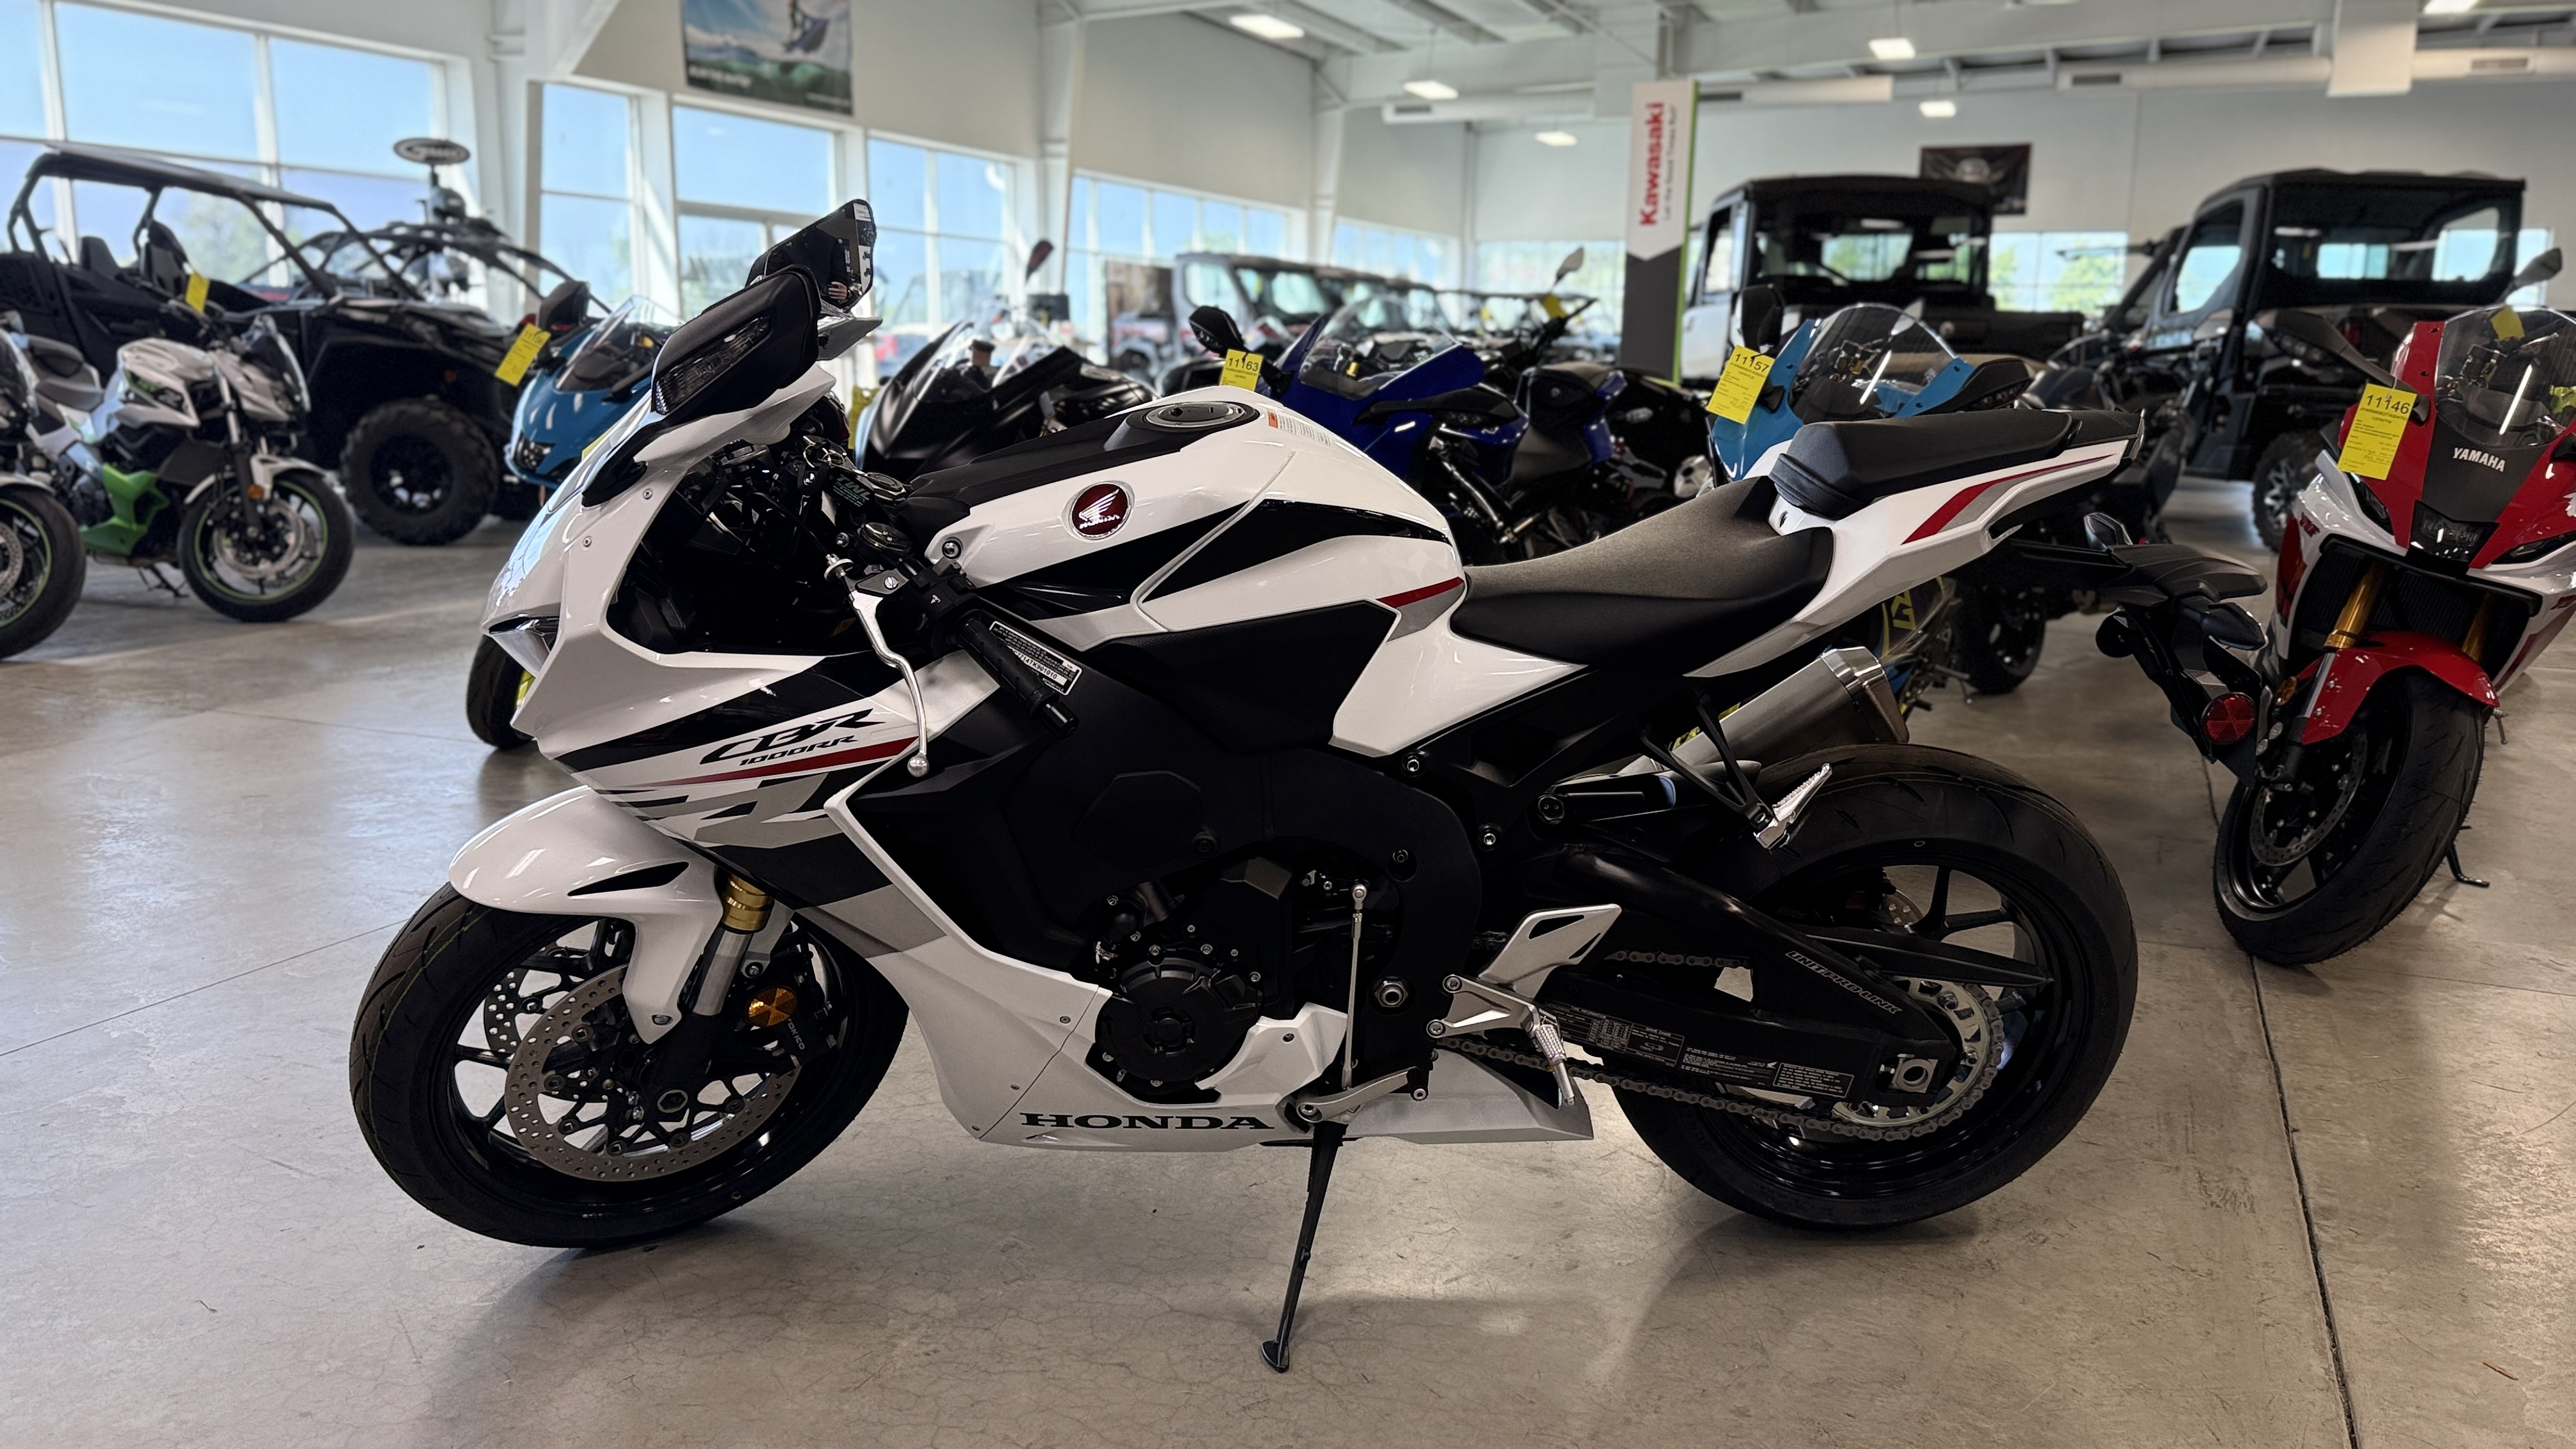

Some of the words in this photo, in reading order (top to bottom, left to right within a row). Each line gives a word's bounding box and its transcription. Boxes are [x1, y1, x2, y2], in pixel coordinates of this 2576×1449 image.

[1639, 102, 1664, 226] Kawasaki
[1229, 357, 1259, 372] 11163
[1735, 353, 1770, 372] 11157
[2366, 394, 2411, 415] 11146
[2453, 447, 2506, 472] YAMAHA
[699, 708, 887, 765] CBR
[739, 735, 859, 766] 1000RR
[1784, 950, 1828, 974] UNIT
[1019, 1112, 1275, 1130] HONDA
